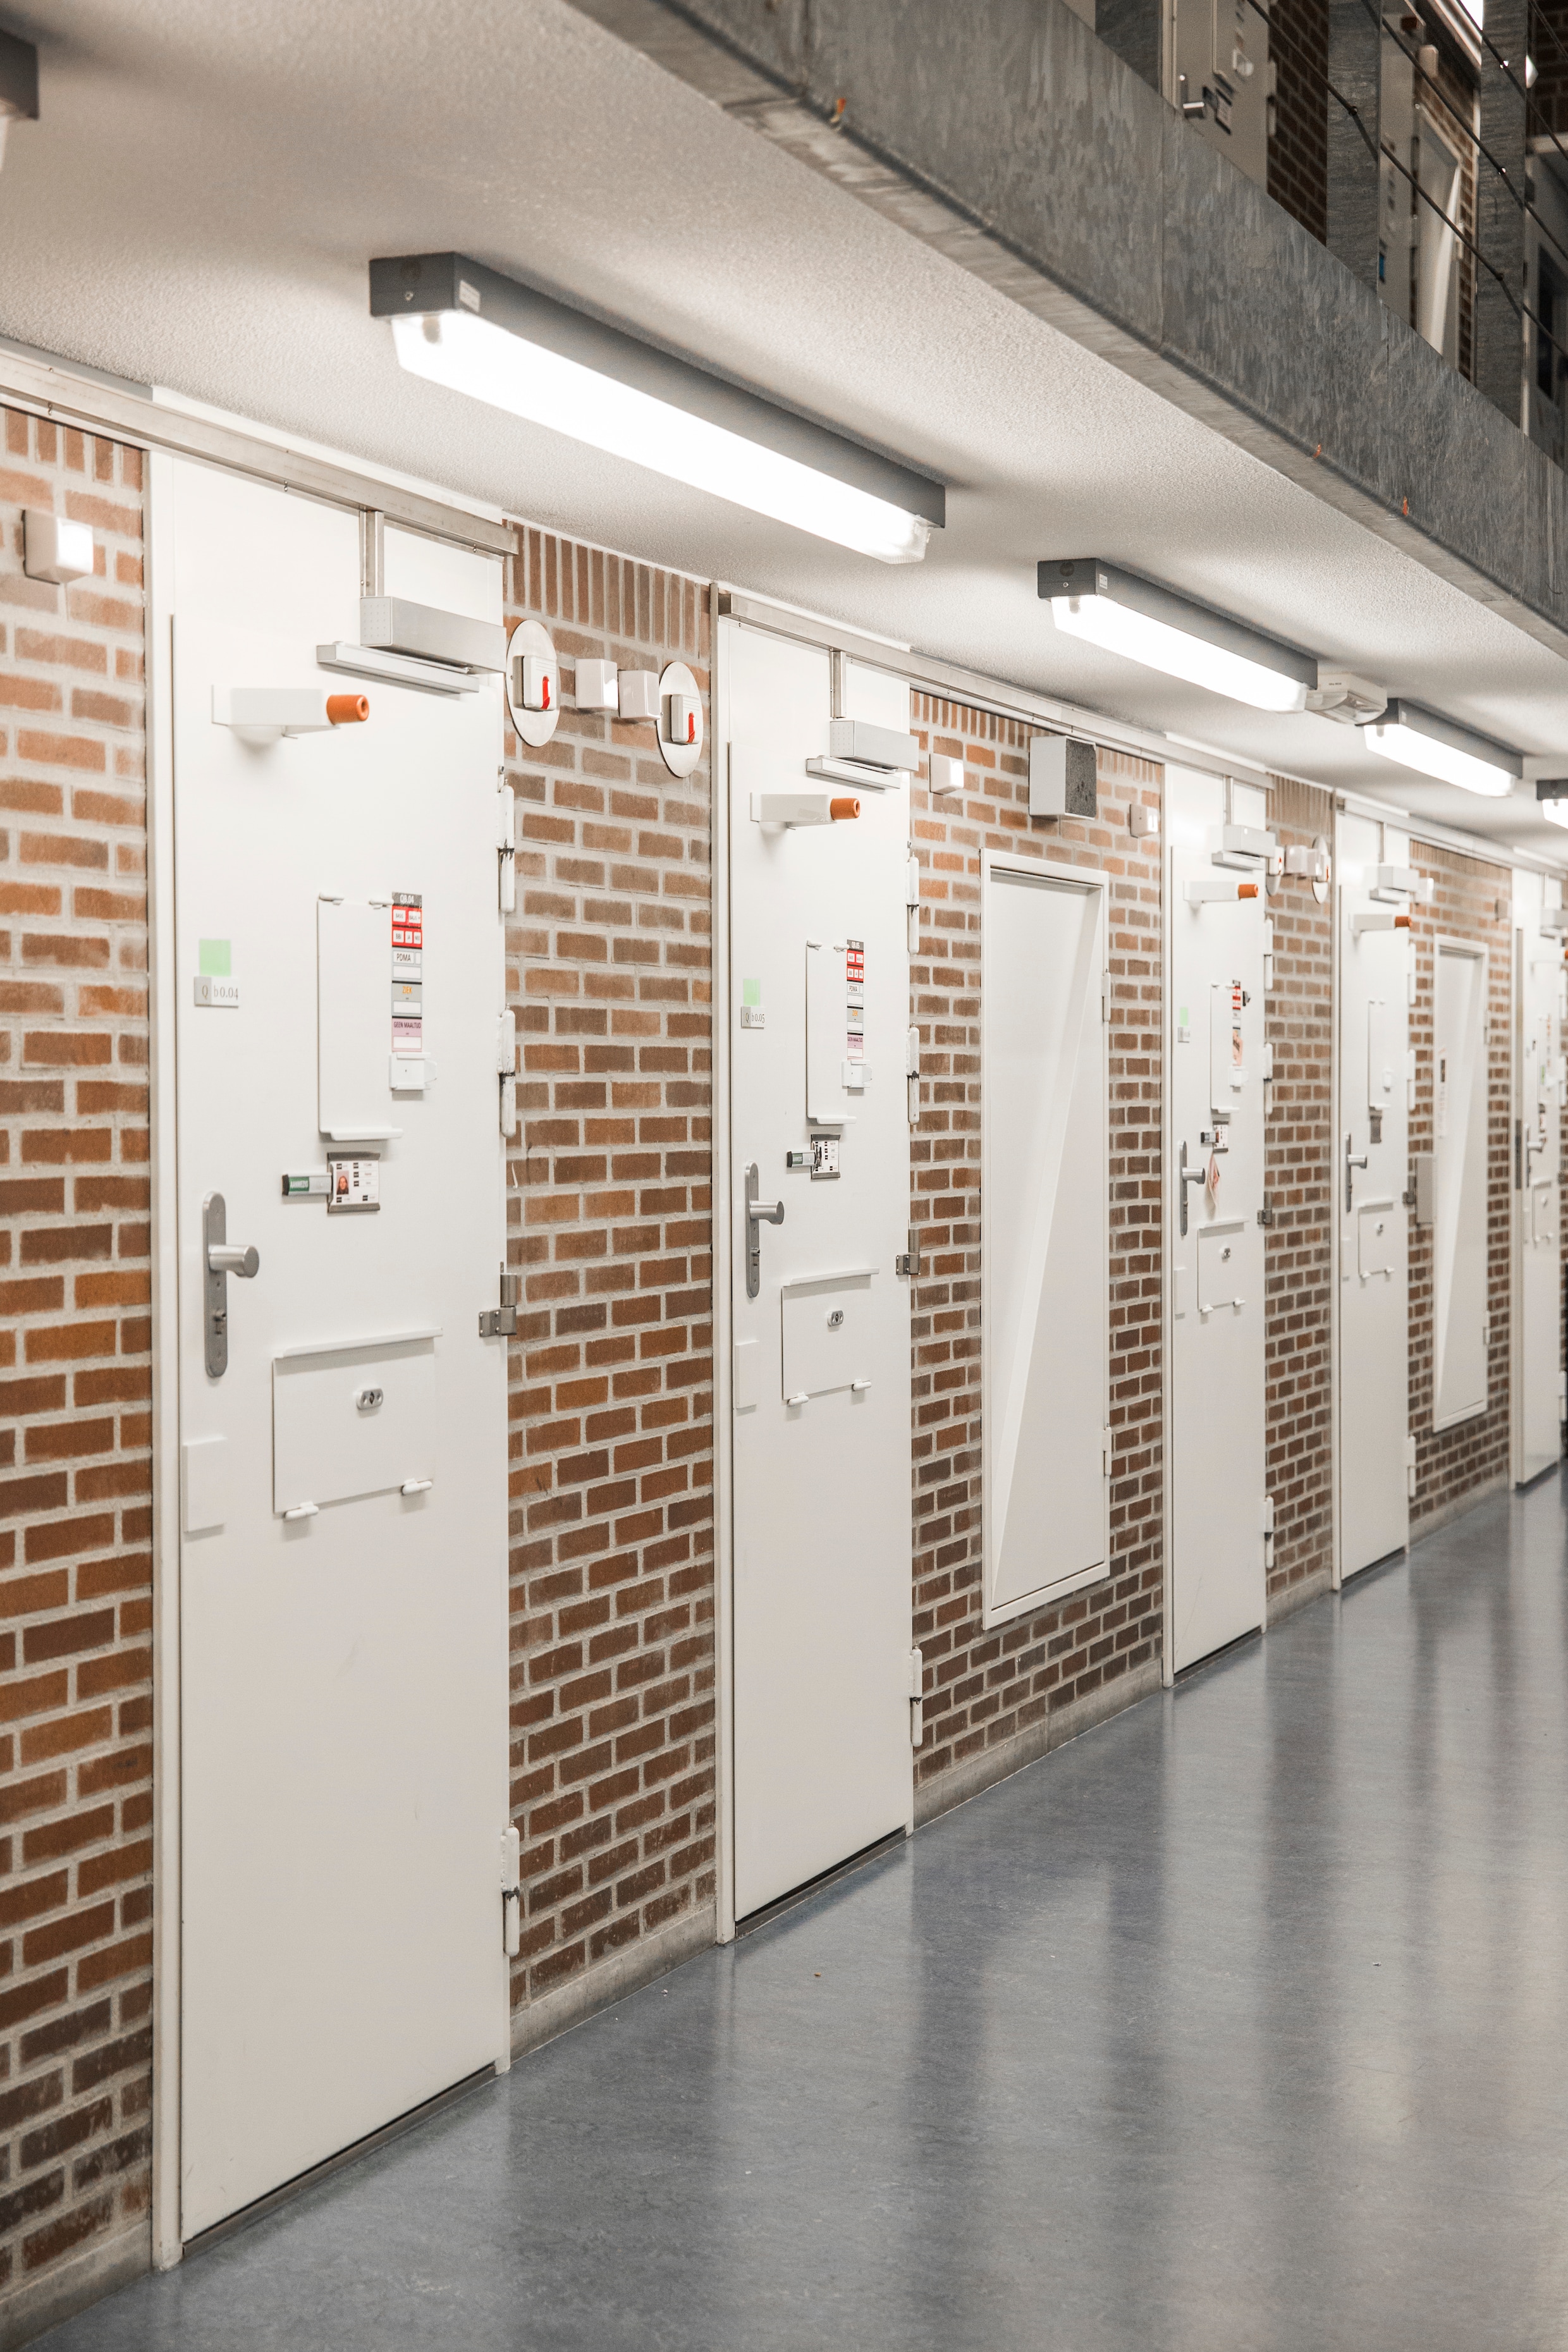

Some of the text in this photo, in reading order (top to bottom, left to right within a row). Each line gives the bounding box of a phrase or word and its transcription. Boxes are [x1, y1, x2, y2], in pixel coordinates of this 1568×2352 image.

[396, 953, 411, 962] PDMA
[202, 984, 208, 1000] Q
[745, 1012, 749, 1023] Q
